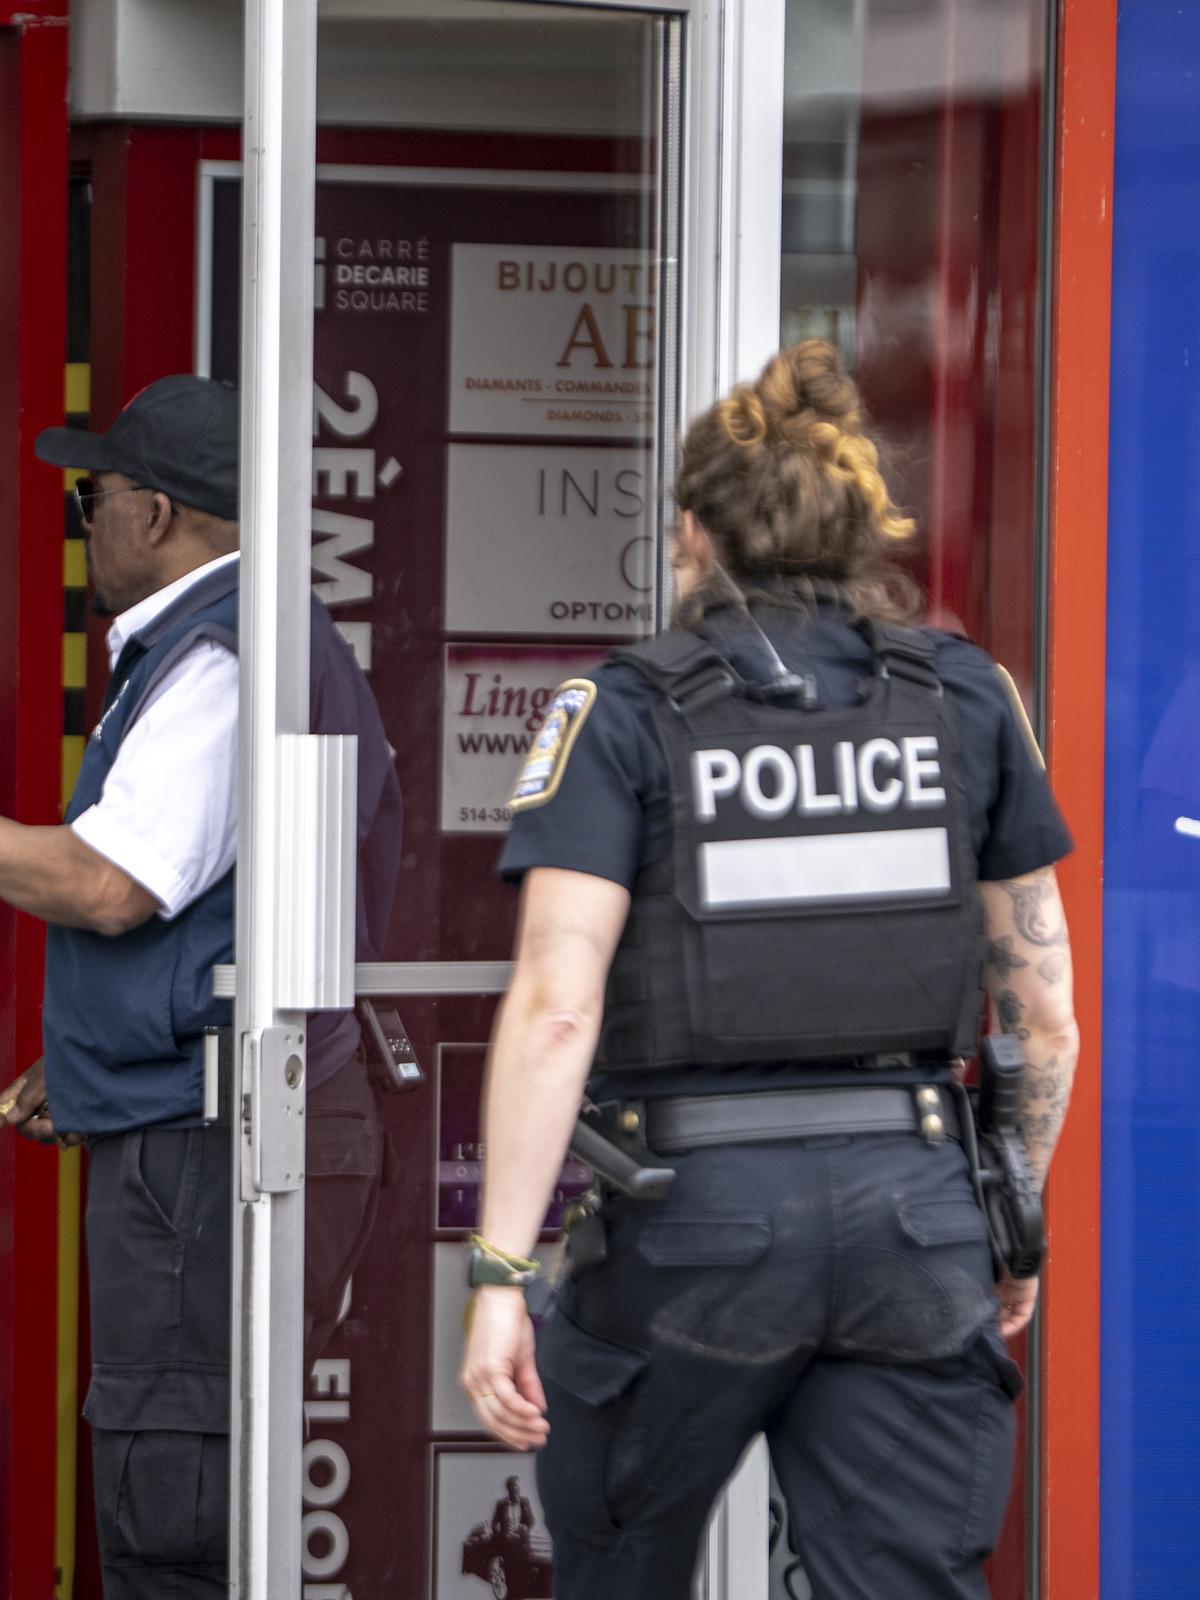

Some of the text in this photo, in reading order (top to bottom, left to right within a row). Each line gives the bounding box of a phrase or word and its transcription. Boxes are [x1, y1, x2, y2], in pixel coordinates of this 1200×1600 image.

[337, 236, 429, 260] CARRÉ
[337, 264, 429, 286] DECARIE
[337, 290, 429, 312] SQUARE
[464, 377, 543, 392] DIAMANTS
[539, 468, 644, 518] INS
[690, 736, 947, 825] POLICE
